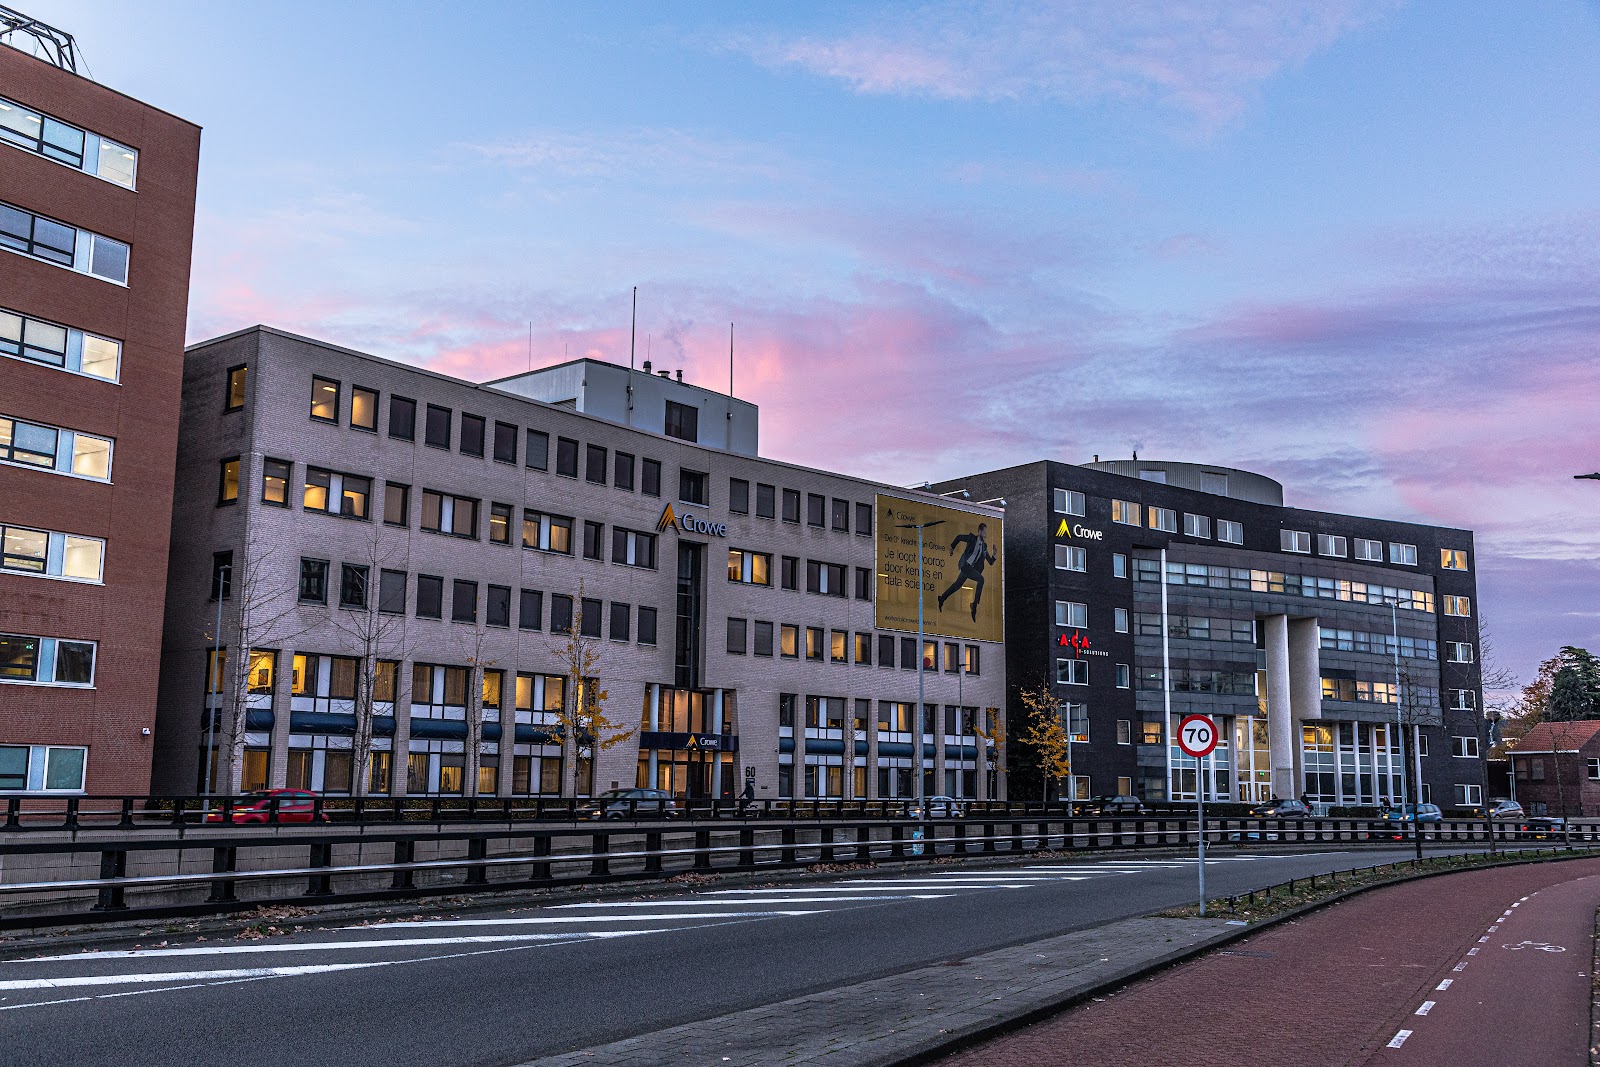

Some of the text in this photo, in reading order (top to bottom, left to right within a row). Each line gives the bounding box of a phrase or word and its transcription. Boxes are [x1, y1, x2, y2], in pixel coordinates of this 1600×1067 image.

[682, 513, 728, 537] Crowe
[896, 511, 916, 523] Crowe
[1074, 524, 1102, 540] Crowe
[884, 533, 893, 543] De
[928, 541, 946, 552] Crowe
[884, 547, 895, 560] Je
[896, 549, 917, 565] loopt
[884, 561, 904, 575] door
[932, 569, 943, 581] en
[884, 574, 935, 592] data science
[700, 737, 718, 746] Crowe
[1184, 727, 1210, 744] 70
[745, 766, 755, 777] 60
